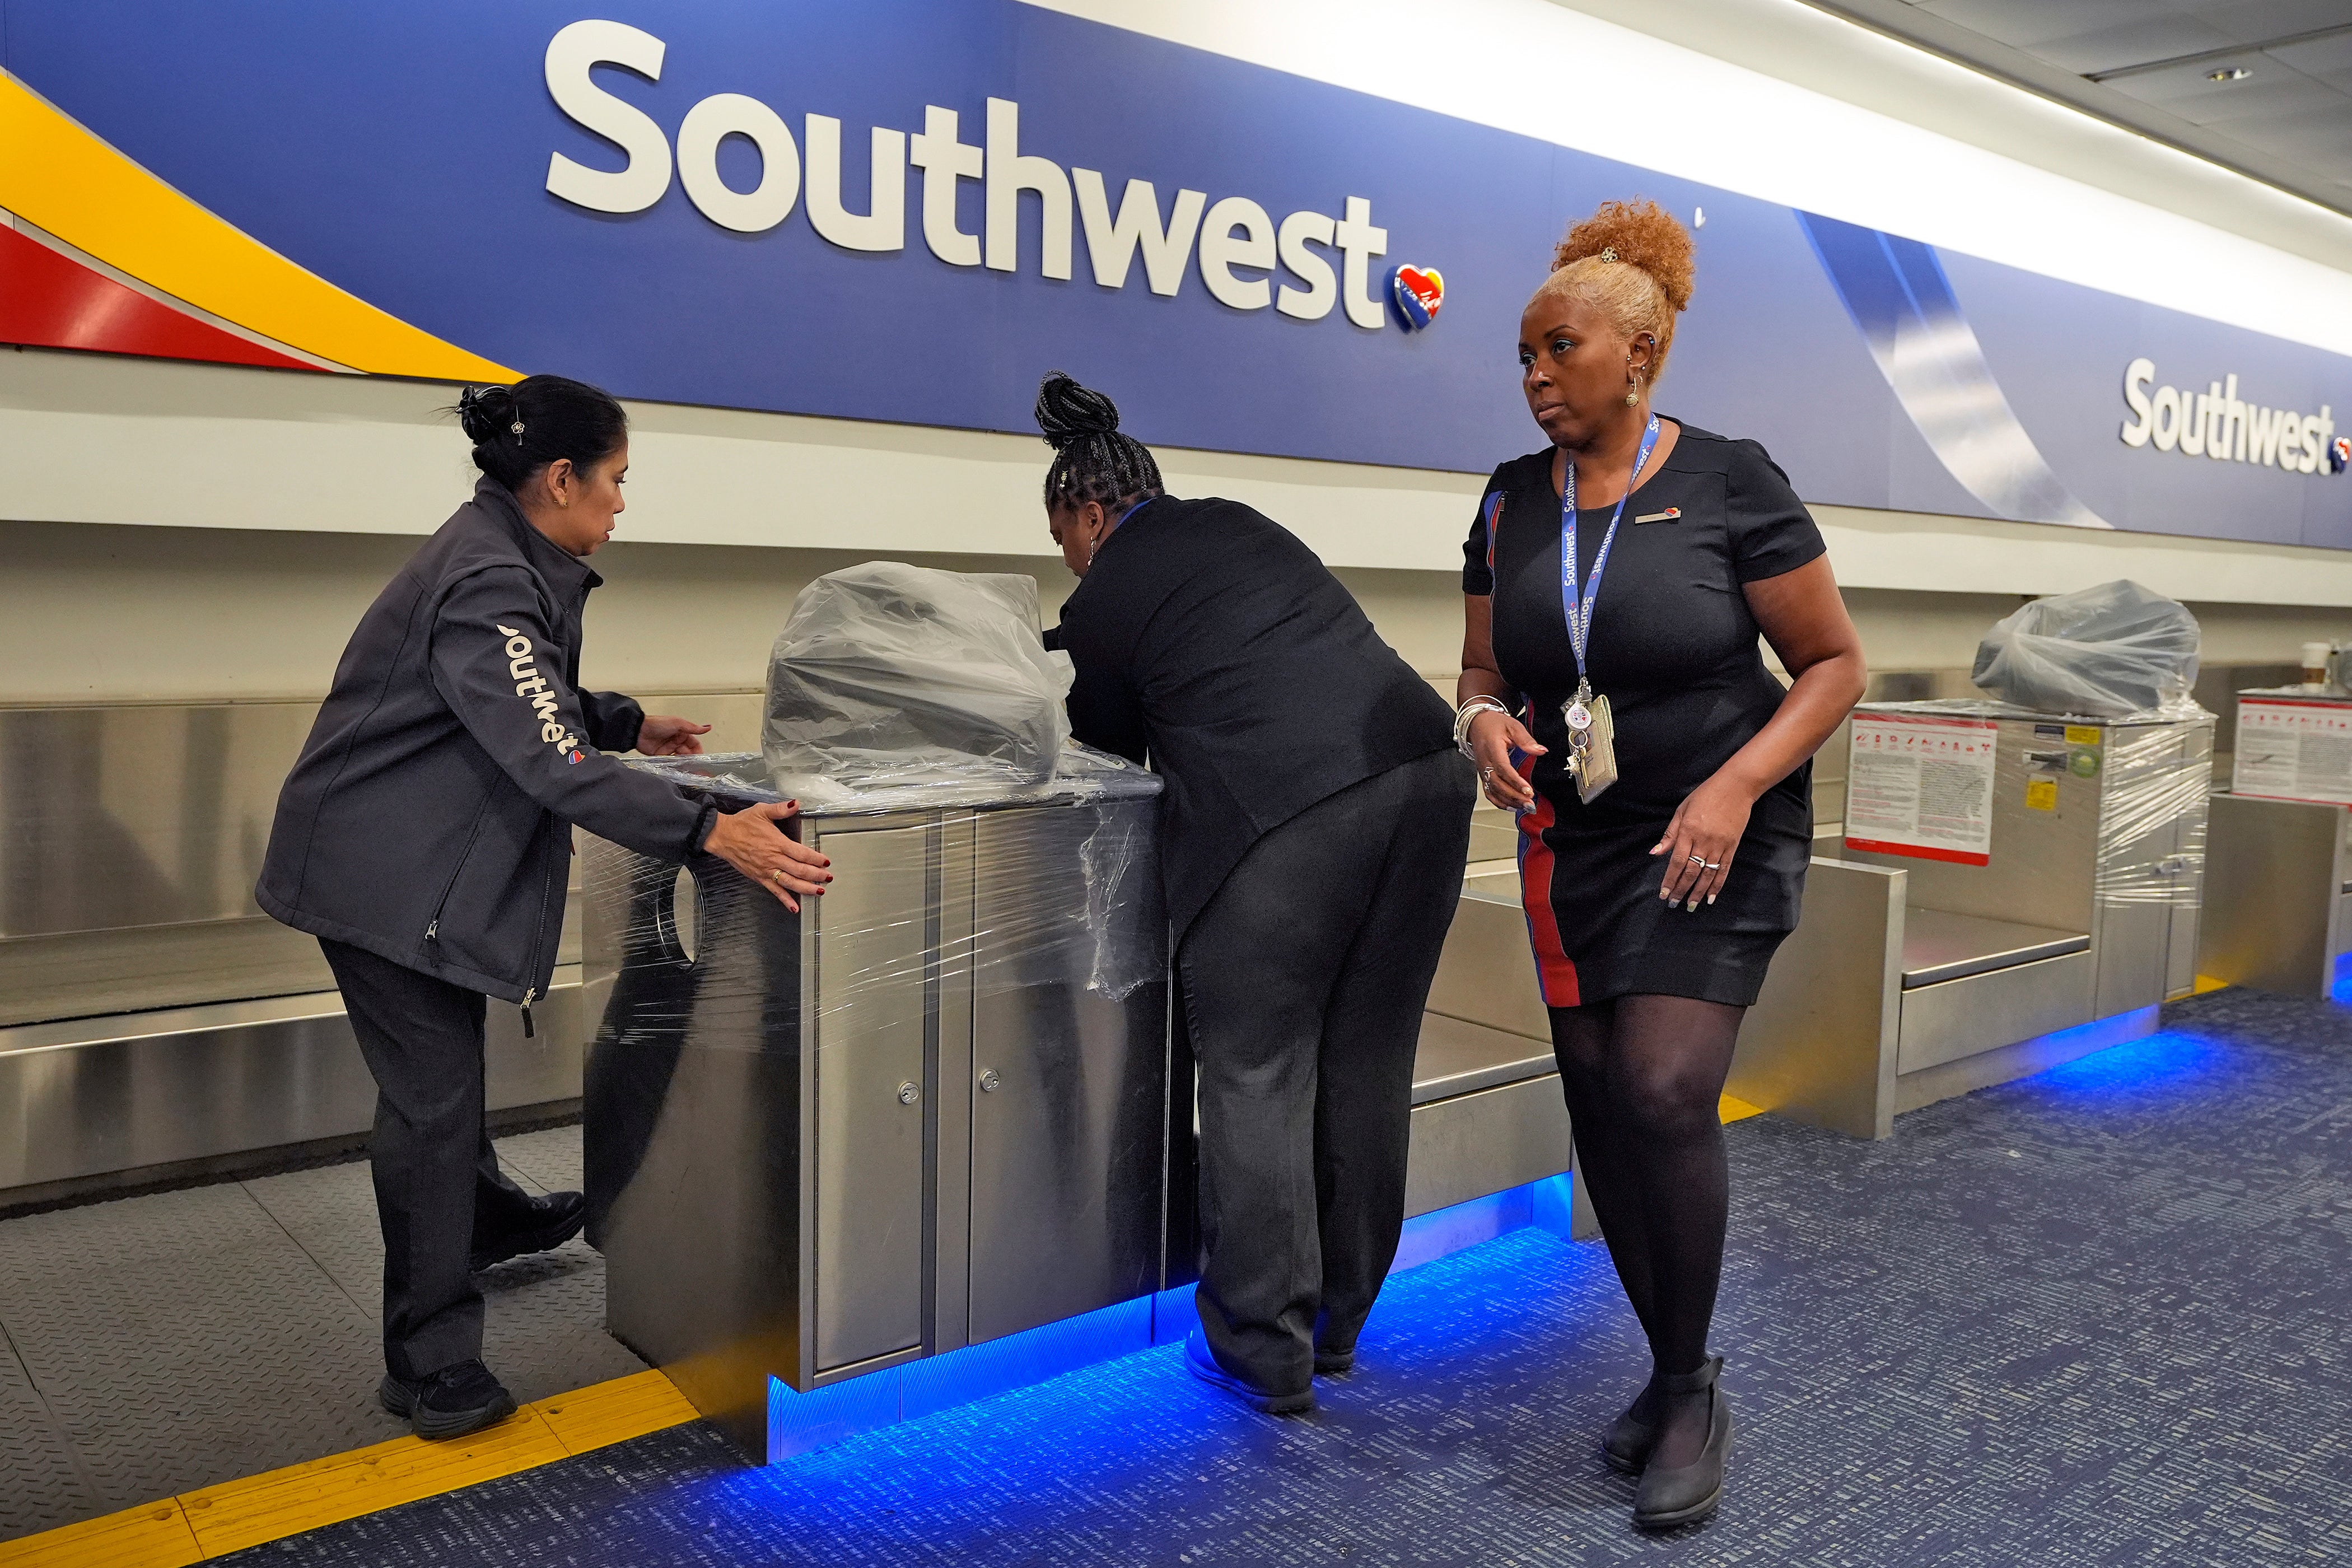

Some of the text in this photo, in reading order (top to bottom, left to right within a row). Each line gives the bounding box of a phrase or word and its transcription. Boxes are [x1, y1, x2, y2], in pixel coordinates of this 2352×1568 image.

[544, 18, 1388, 329] Southwest
[2120, 357, 2335, 475] Southwest
[1563, 530, 1575, 587] Southwest
[1592, 515, 1619, 574] Southwest
